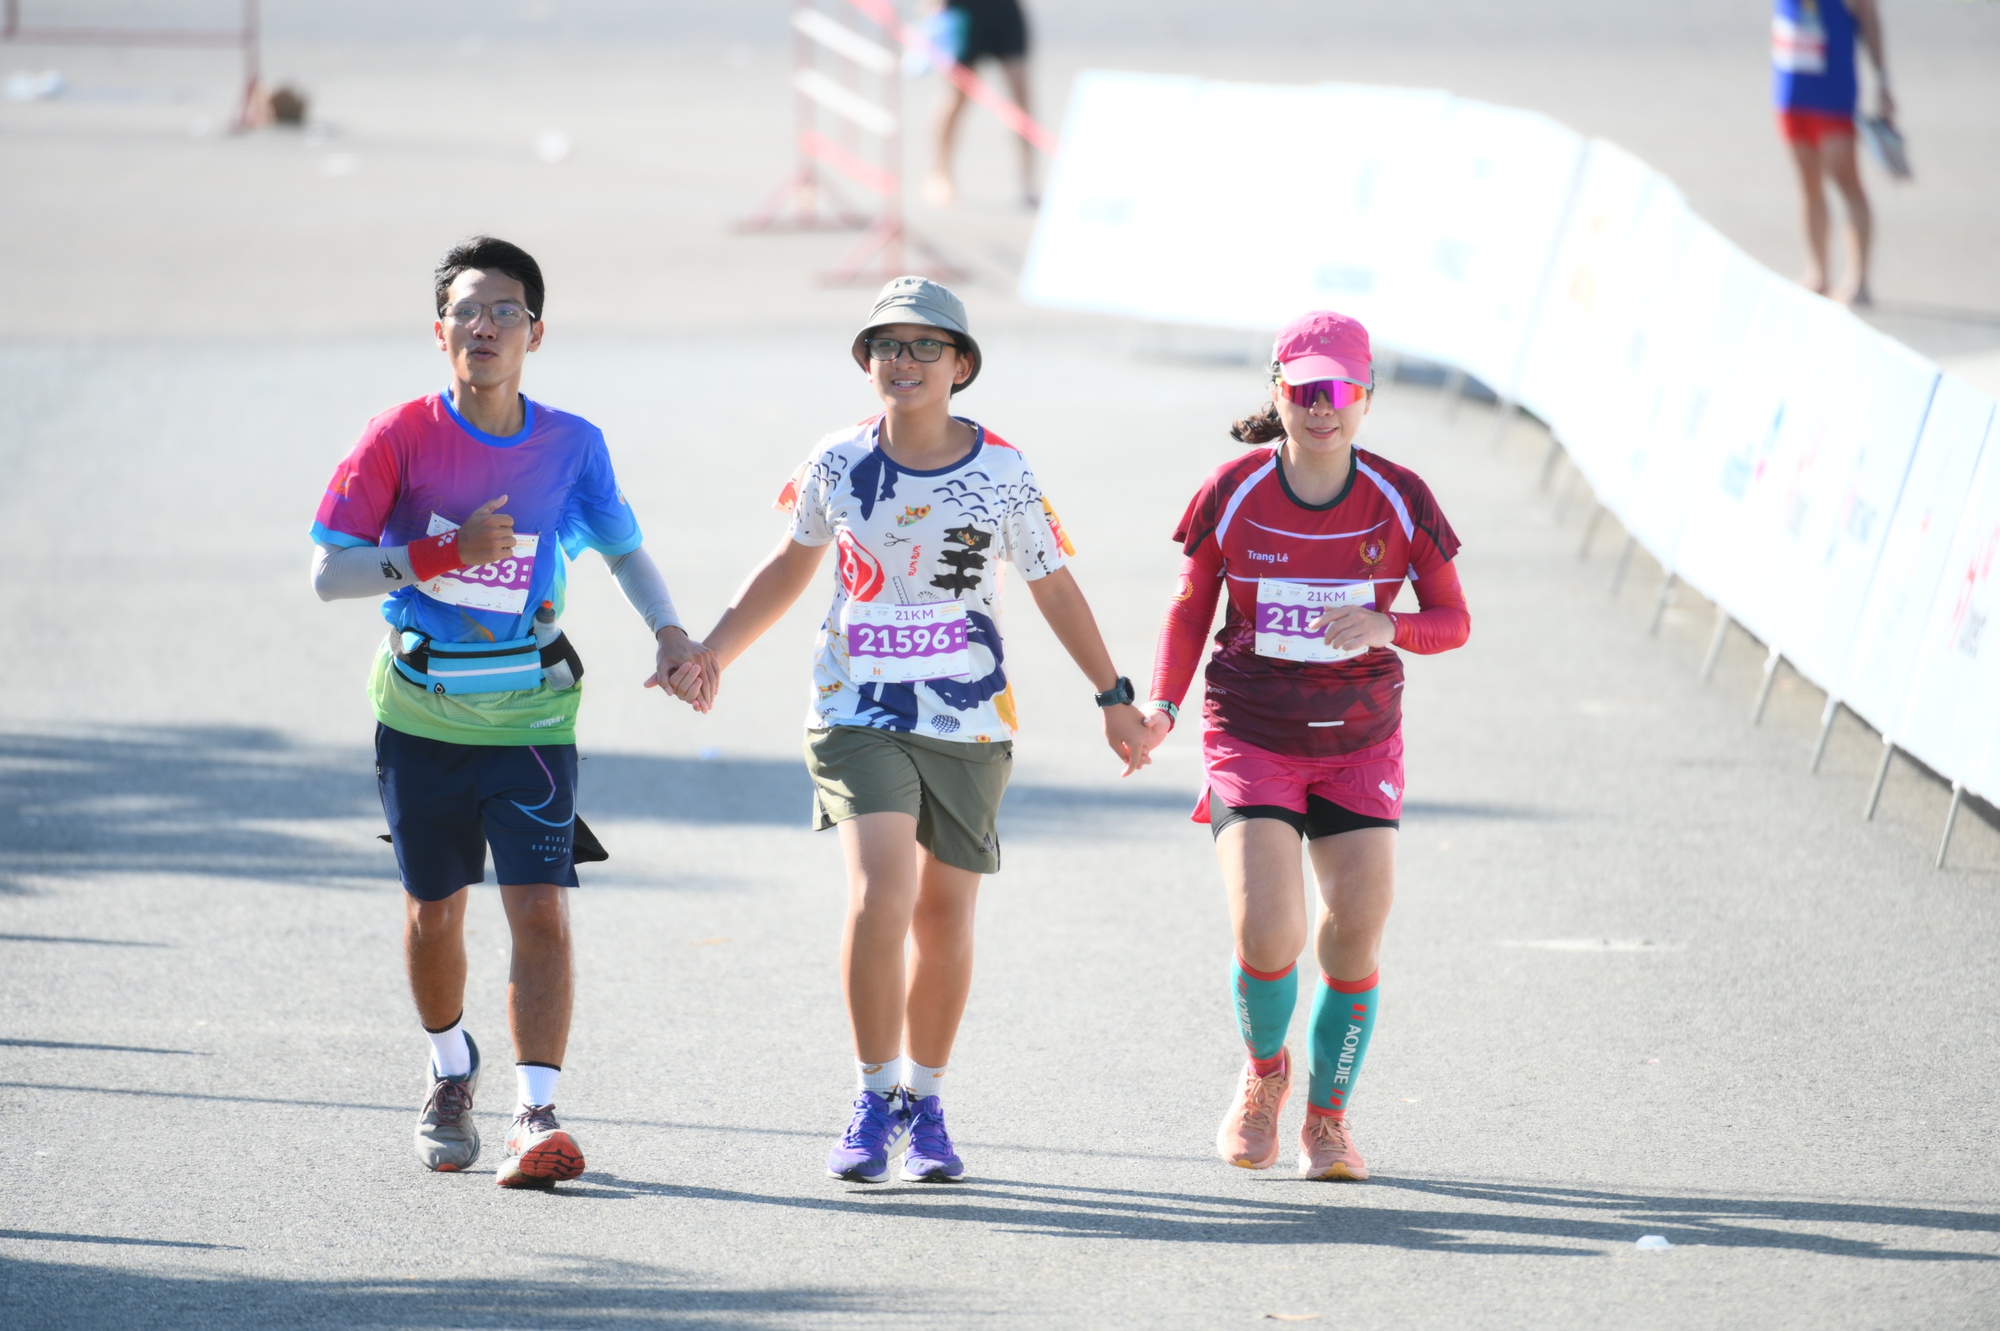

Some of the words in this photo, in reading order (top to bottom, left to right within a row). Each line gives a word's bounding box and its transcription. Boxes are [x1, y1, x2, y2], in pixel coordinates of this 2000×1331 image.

[1247, 550, 1275, 563] Trang
[1277, 552, 1289, 562] Lê
[447, 559, 518, 584] 253
[1307, 591, 1346, 602] 21KM
[895, 609, 934, 621] 21KM
[1266, 607, 1328, 634] 215
[858, 626, 951, 653] 21596
[1333, 1024, 1363, 1085] AONIJIE
